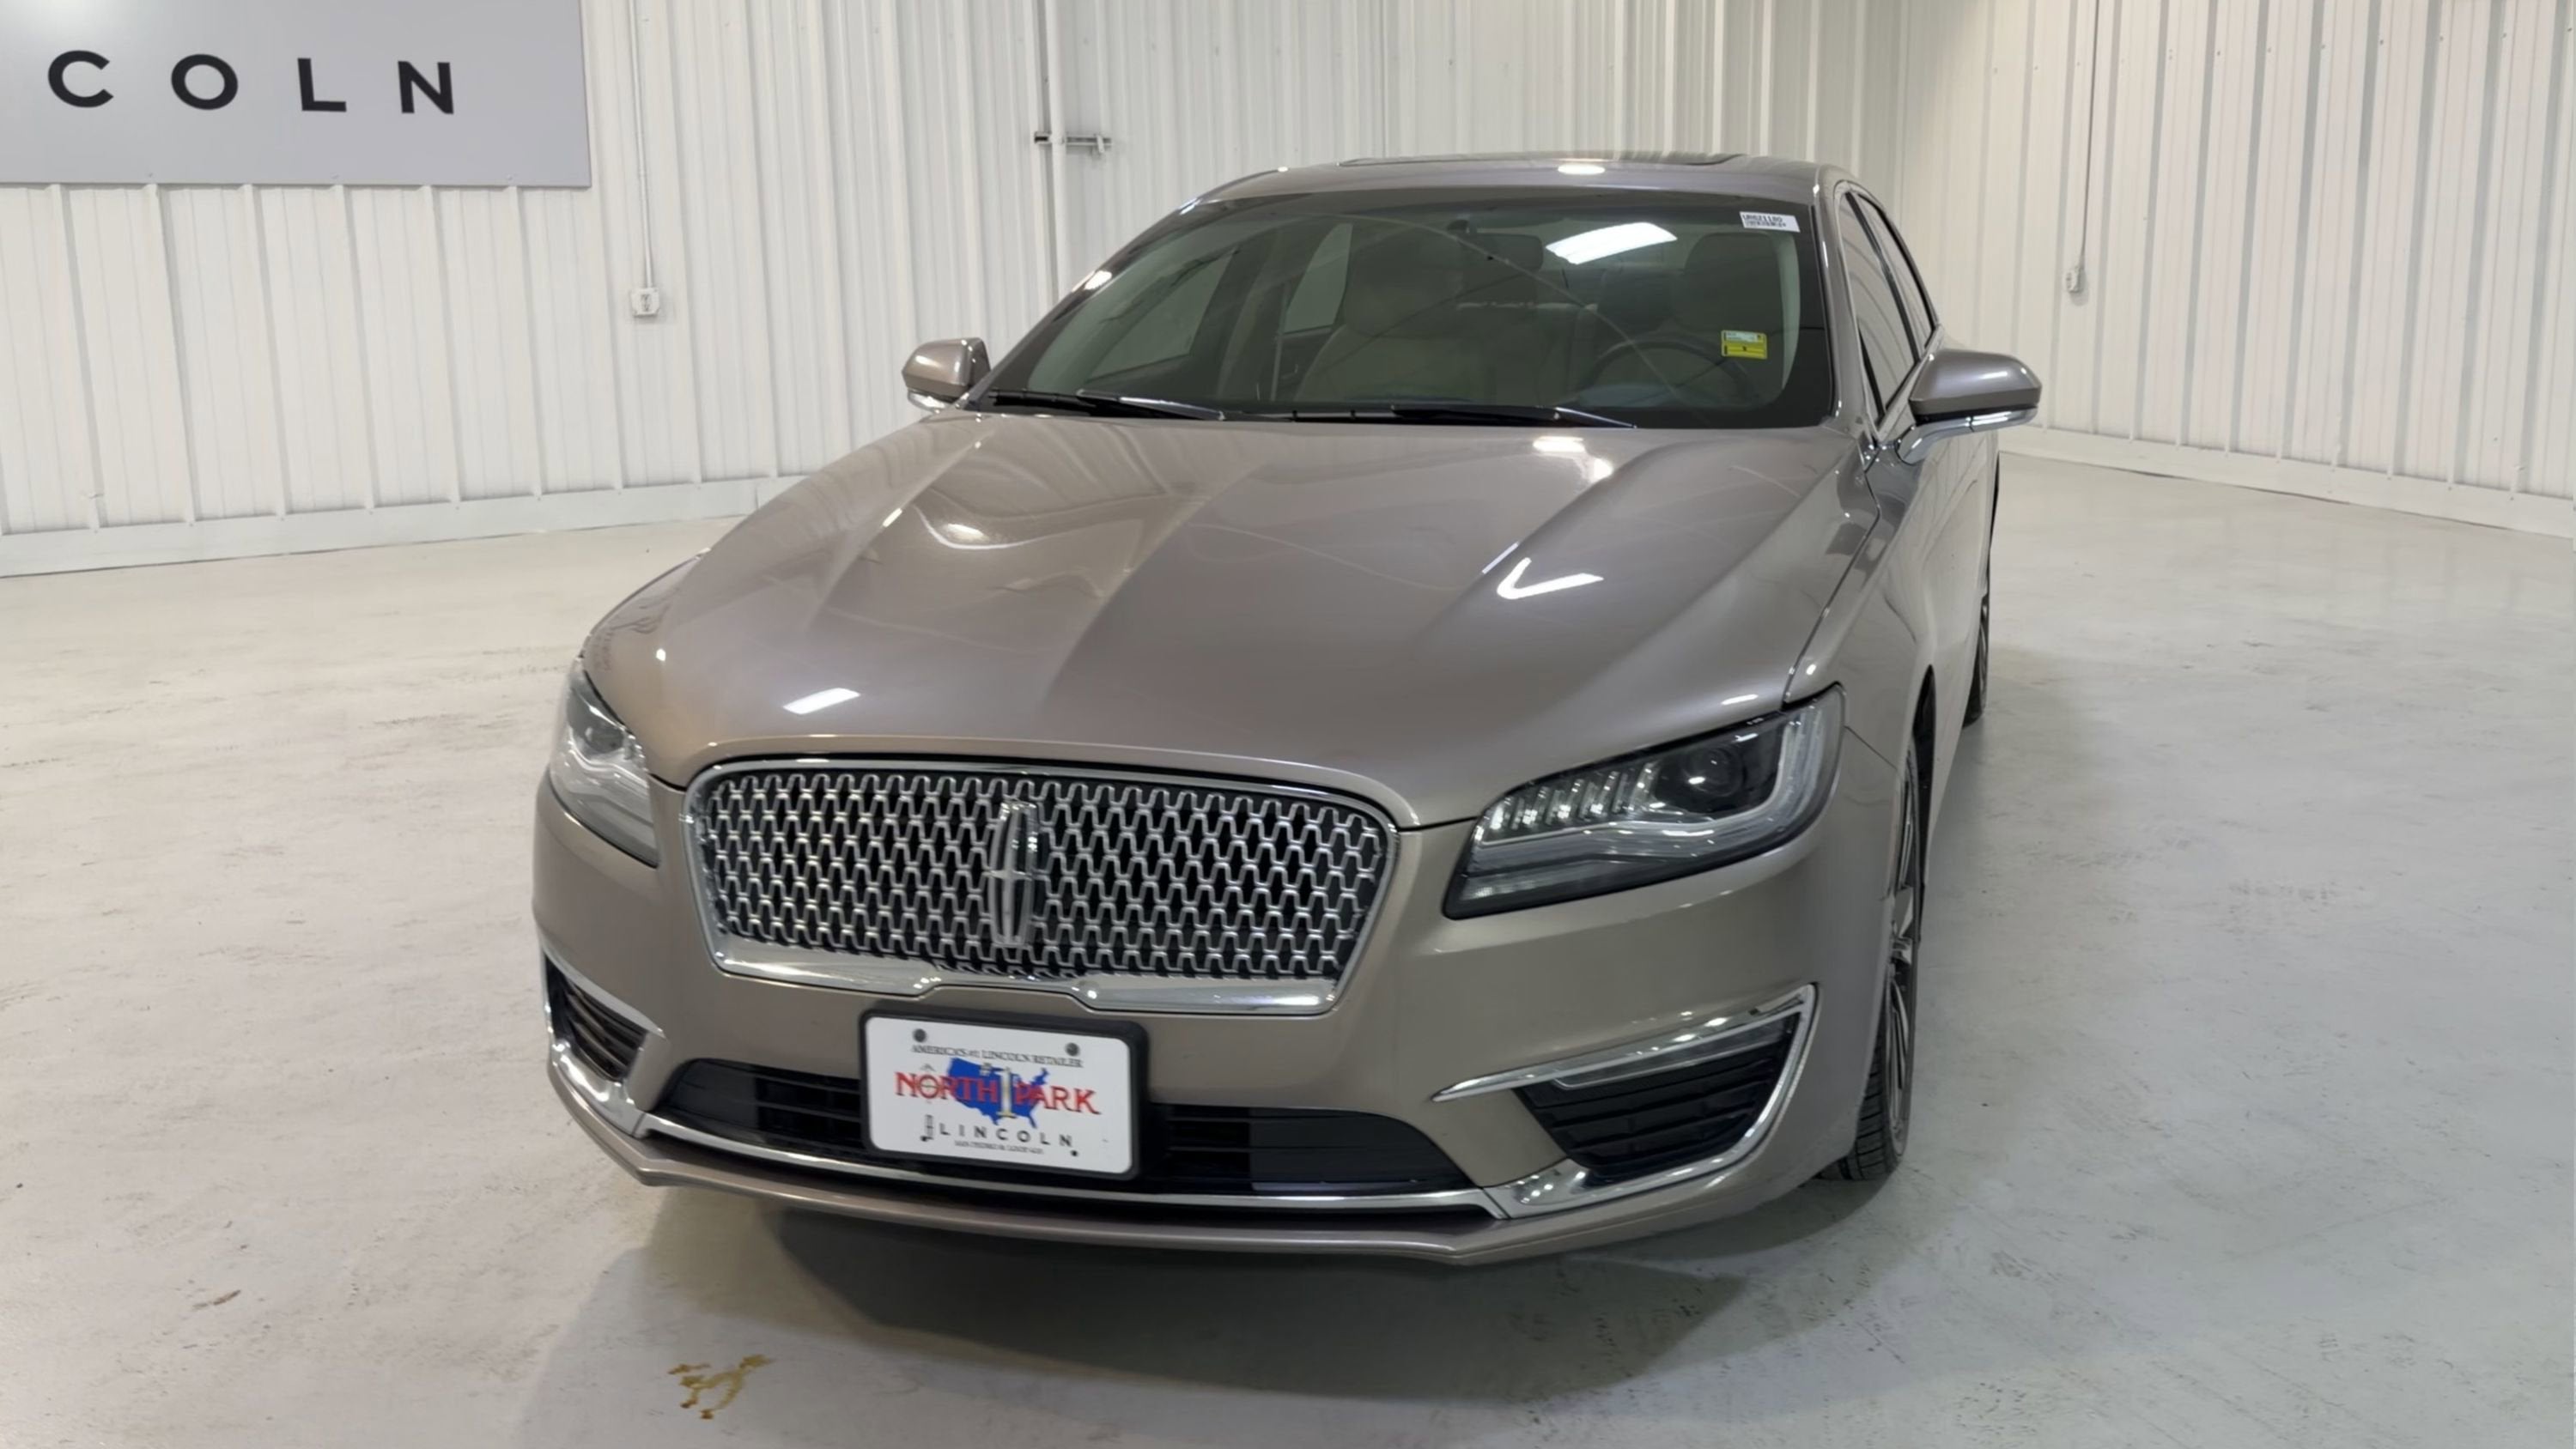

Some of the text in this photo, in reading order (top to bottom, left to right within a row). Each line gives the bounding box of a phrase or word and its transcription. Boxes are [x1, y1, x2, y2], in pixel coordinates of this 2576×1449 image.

[981, 1049, 1030, 1063] LINCOLN
[1032, 1055, 1083, 1068] RETAILER
[895, 1071, 1102, 1115] NORTH PARK
[939, 1123, 1072, 1147] LINCOLN
